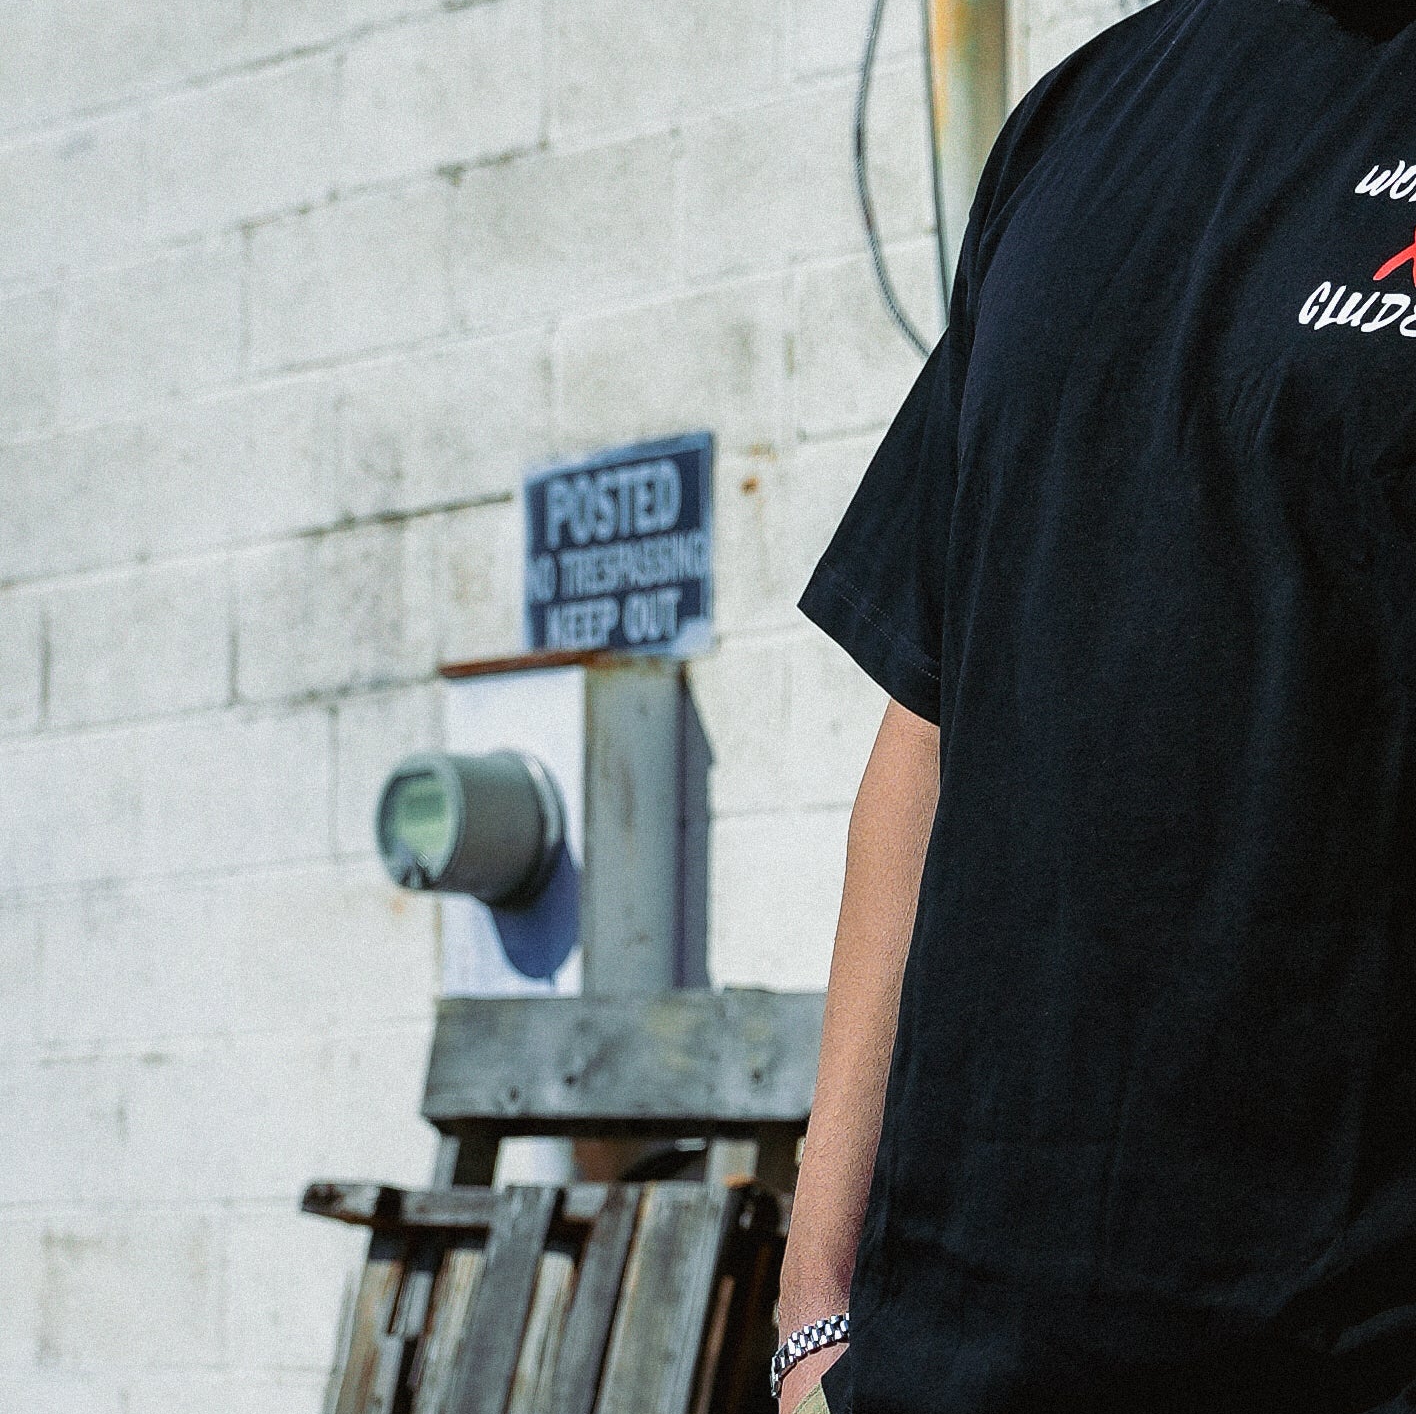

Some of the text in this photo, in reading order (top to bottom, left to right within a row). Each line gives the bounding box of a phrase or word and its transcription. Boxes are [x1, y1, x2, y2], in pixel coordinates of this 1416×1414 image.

[545, 457, 682, 549] POSTED
[546, 587, 682, 651] KEEP OUT
